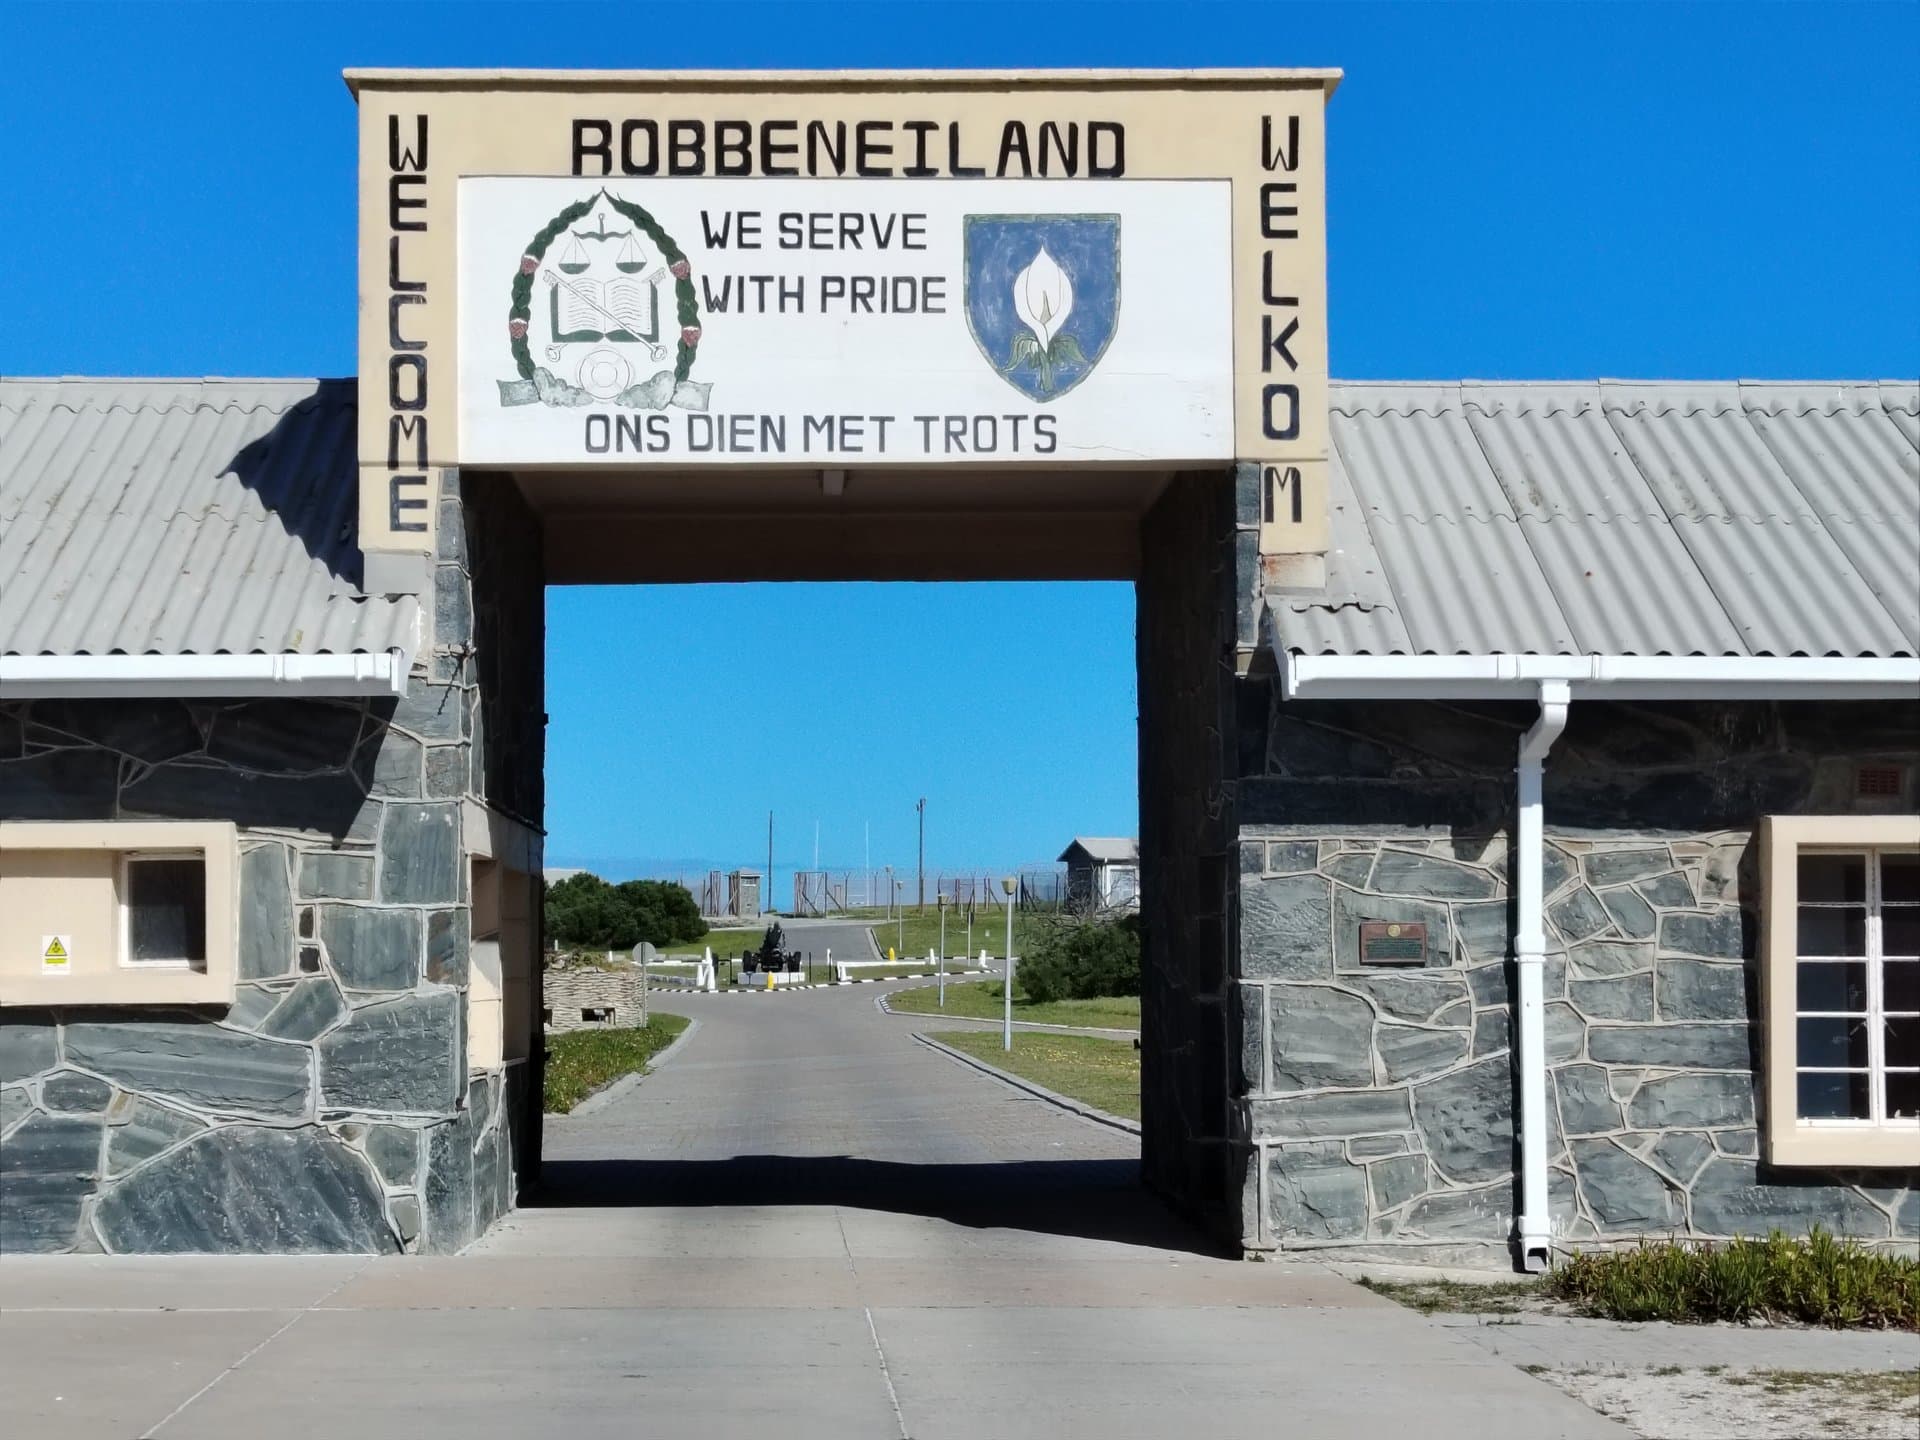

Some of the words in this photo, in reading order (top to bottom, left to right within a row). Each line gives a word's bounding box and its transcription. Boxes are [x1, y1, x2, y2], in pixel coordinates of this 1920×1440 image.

[572, 119, 1126, 177] ROBBENEILAND
[701, 211, 762, 250] WE
[779, 213, 927, 250] SERVE
[702, 275, 804, 314] WITH
[821, 276, 947, 314] PRIDE
[388, 115, 429, 531] WELCOME
[1260, 116, 1302, 524] WELKOM
[585, 414, 671, 453] ONS
[688, 414, 786, 452] DIEN
[803, 415, 896, 453] MET
[914, 415, 1057, 453] TROTS
